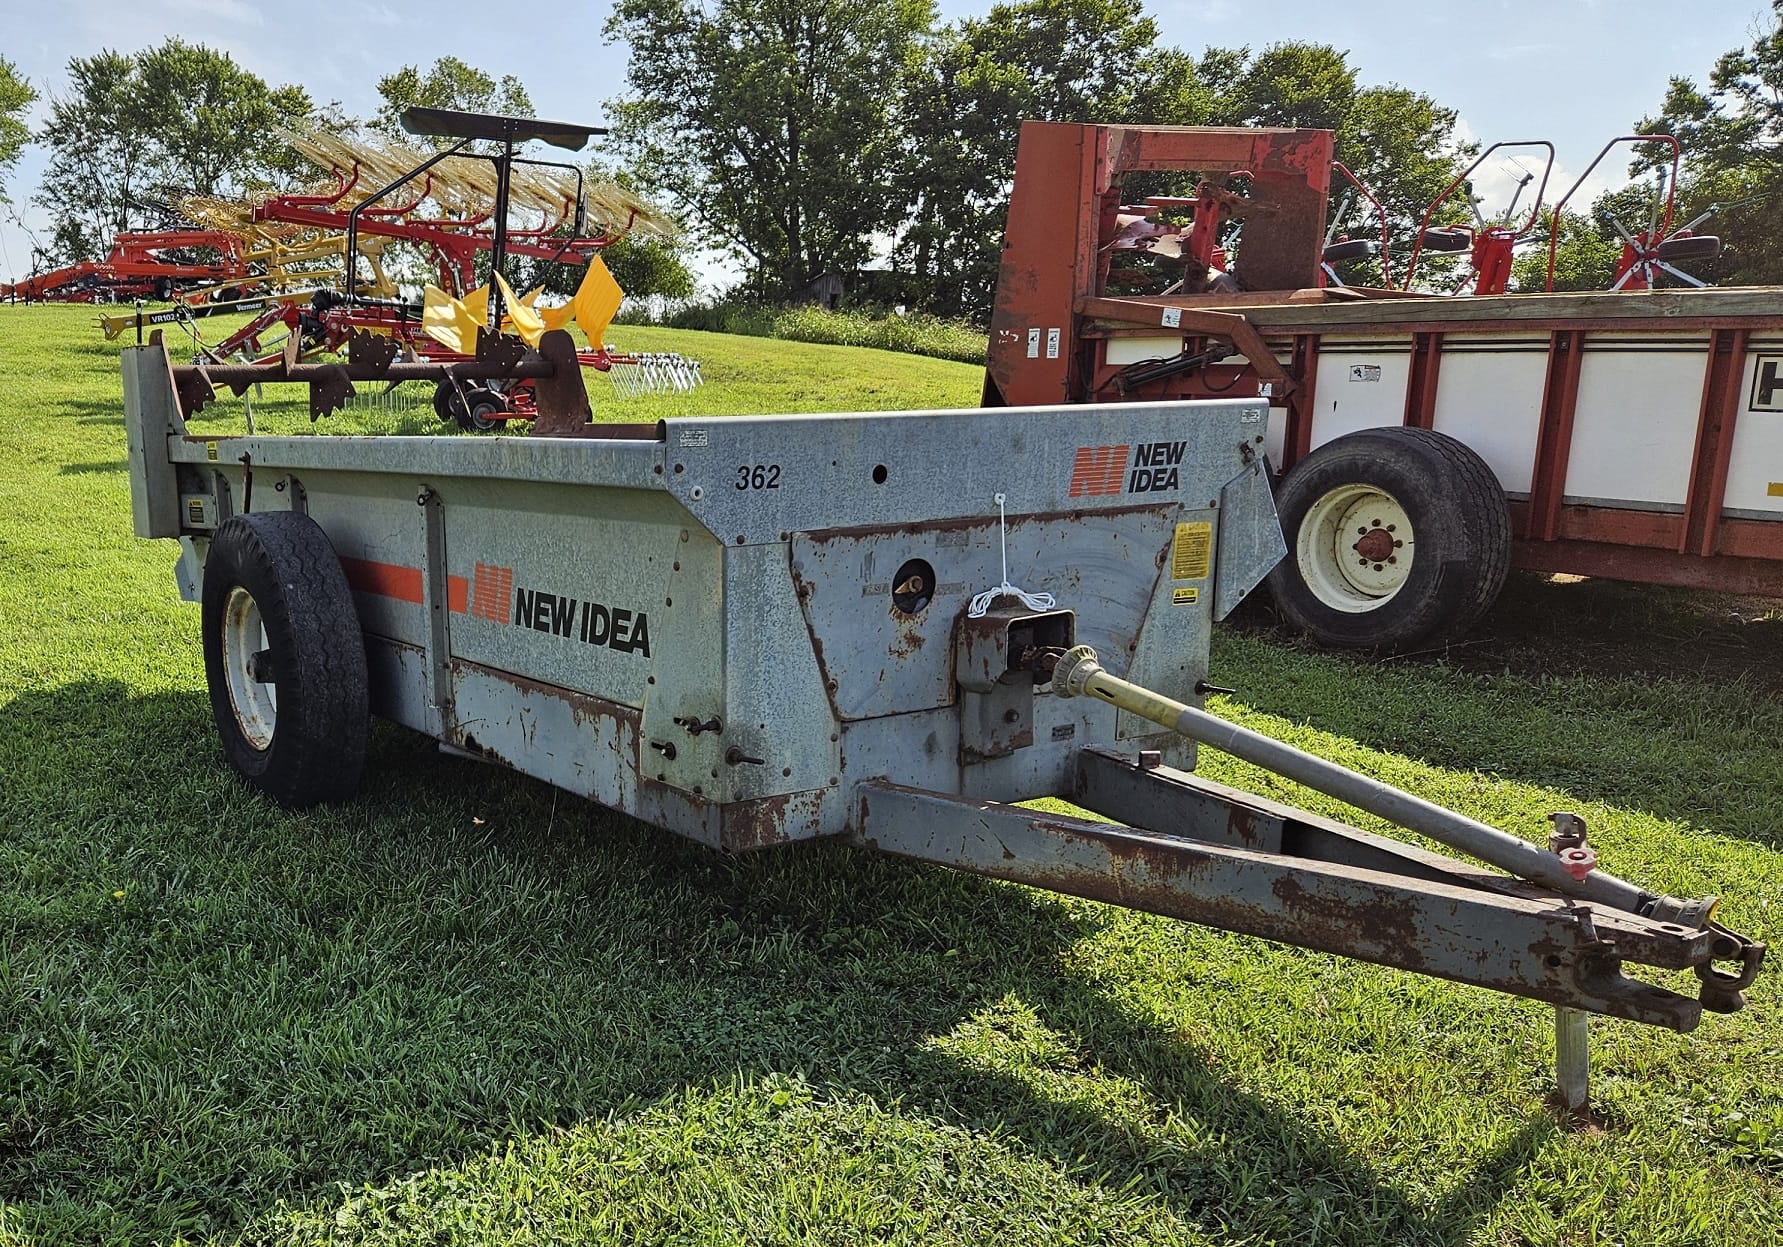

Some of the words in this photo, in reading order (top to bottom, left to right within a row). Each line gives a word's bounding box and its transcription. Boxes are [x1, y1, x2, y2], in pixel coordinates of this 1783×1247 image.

[151, 313, 175, 323] VR102
[235, 302, 262, 311] Vermeer
[1134, 441, 1188, 467] NEW
[735, 464, 781, 491] 362
[1128, 467, 1179, 493] IDEA
[515, 587, 578, 638] NEW
[580, 601, 651, 659] IDEA
